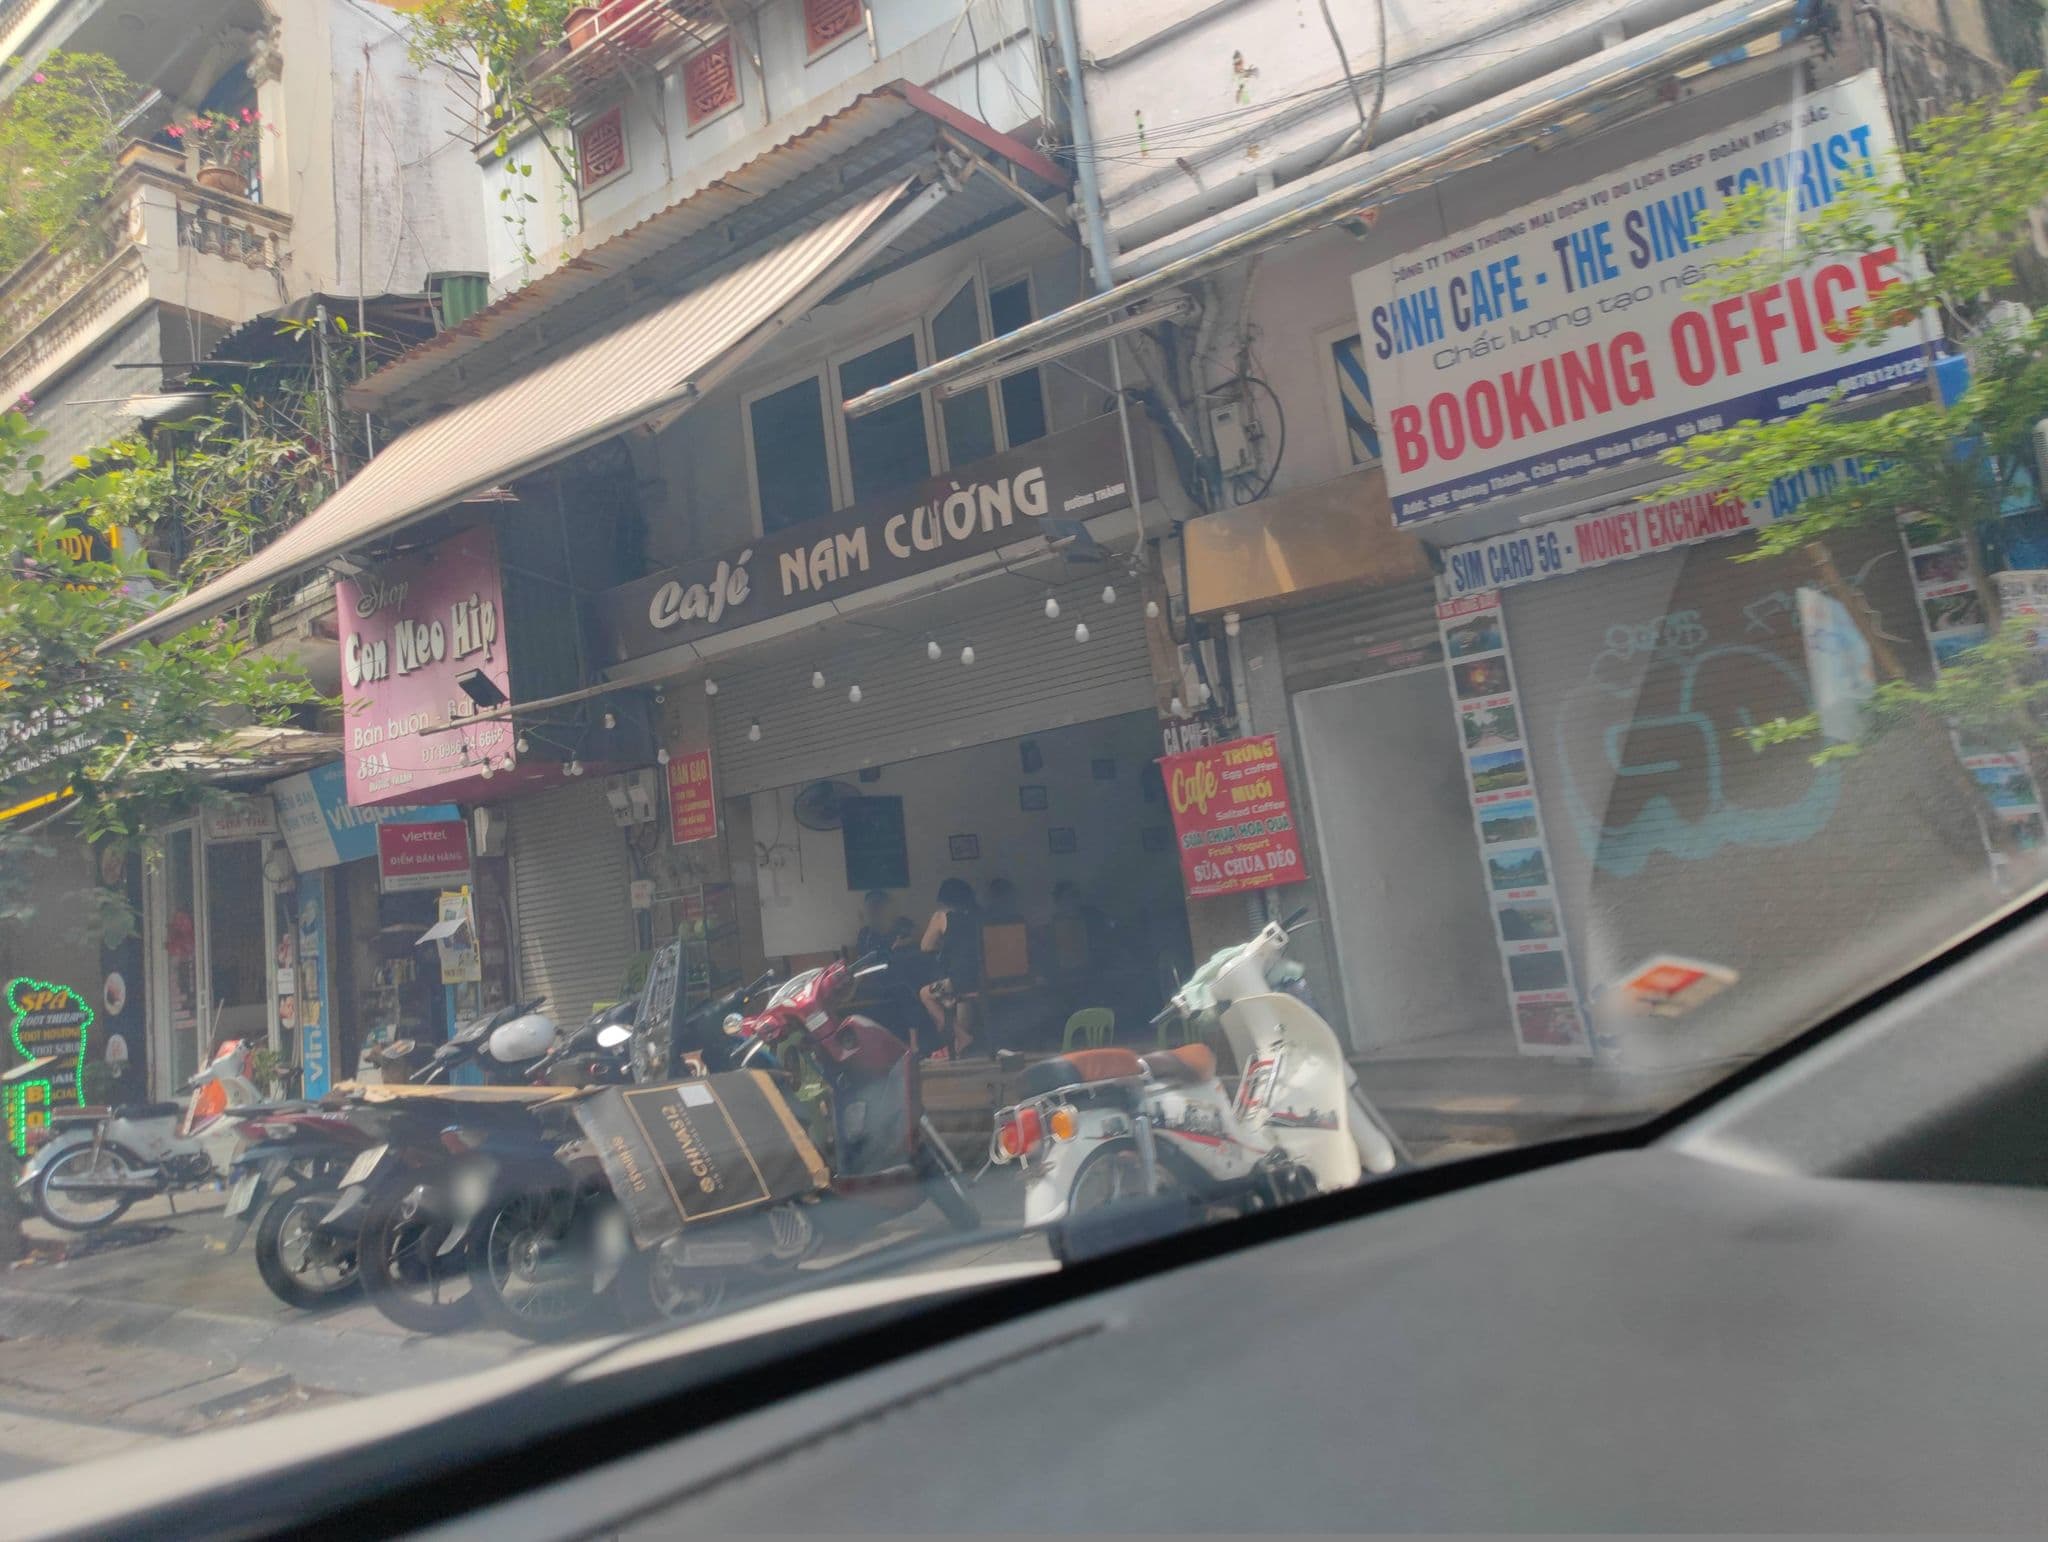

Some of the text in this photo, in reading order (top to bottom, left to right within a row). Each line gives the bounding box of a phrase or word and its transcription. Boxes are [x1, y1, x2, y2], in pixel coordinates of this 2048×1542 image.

[1426, 256, 1440, 270] TY
[1633, 169, 1667, 191] LỊCH
[1371, 285, 1444, 359] SINH
[1449, 254, 1530, 333] CAFE
[1552, 221, 1621, 295] THE
[1624, 185, 1707, 269] SINH
[1432, 321, 1506, 372] Chất
[1598, 280, 1654, 317] tạo
[1390, 248, 1917, 475] BOOKING OFFICE
[649, 467, 1049, 629] Café NAM CƯỜNG
[1452, 549, 1486, 594] SIM
[1488, 537, 1536, 584] CARD
[1536, 531, 1563, 572] 5G
[1574, 510, 1642, 565] MONEY
[1646, 486, 1753, 548] EXCHANGE
[355, 580, 409, 619] Shop
[346, 633, 389, 688] Con
[353, 722, 384, 750] Bán
[326, 797, 425, 831] vinaph
[1172, 760, 1218, 815] Café
[390, 854, 414, 866] ĐIỂM
[401, 830, 448, 842] viettel
[1193, 860, 1222, 882] SỮA
[1223, 854, 1265, 877] CHUA
[20, 991, 69, 1012] SPA
